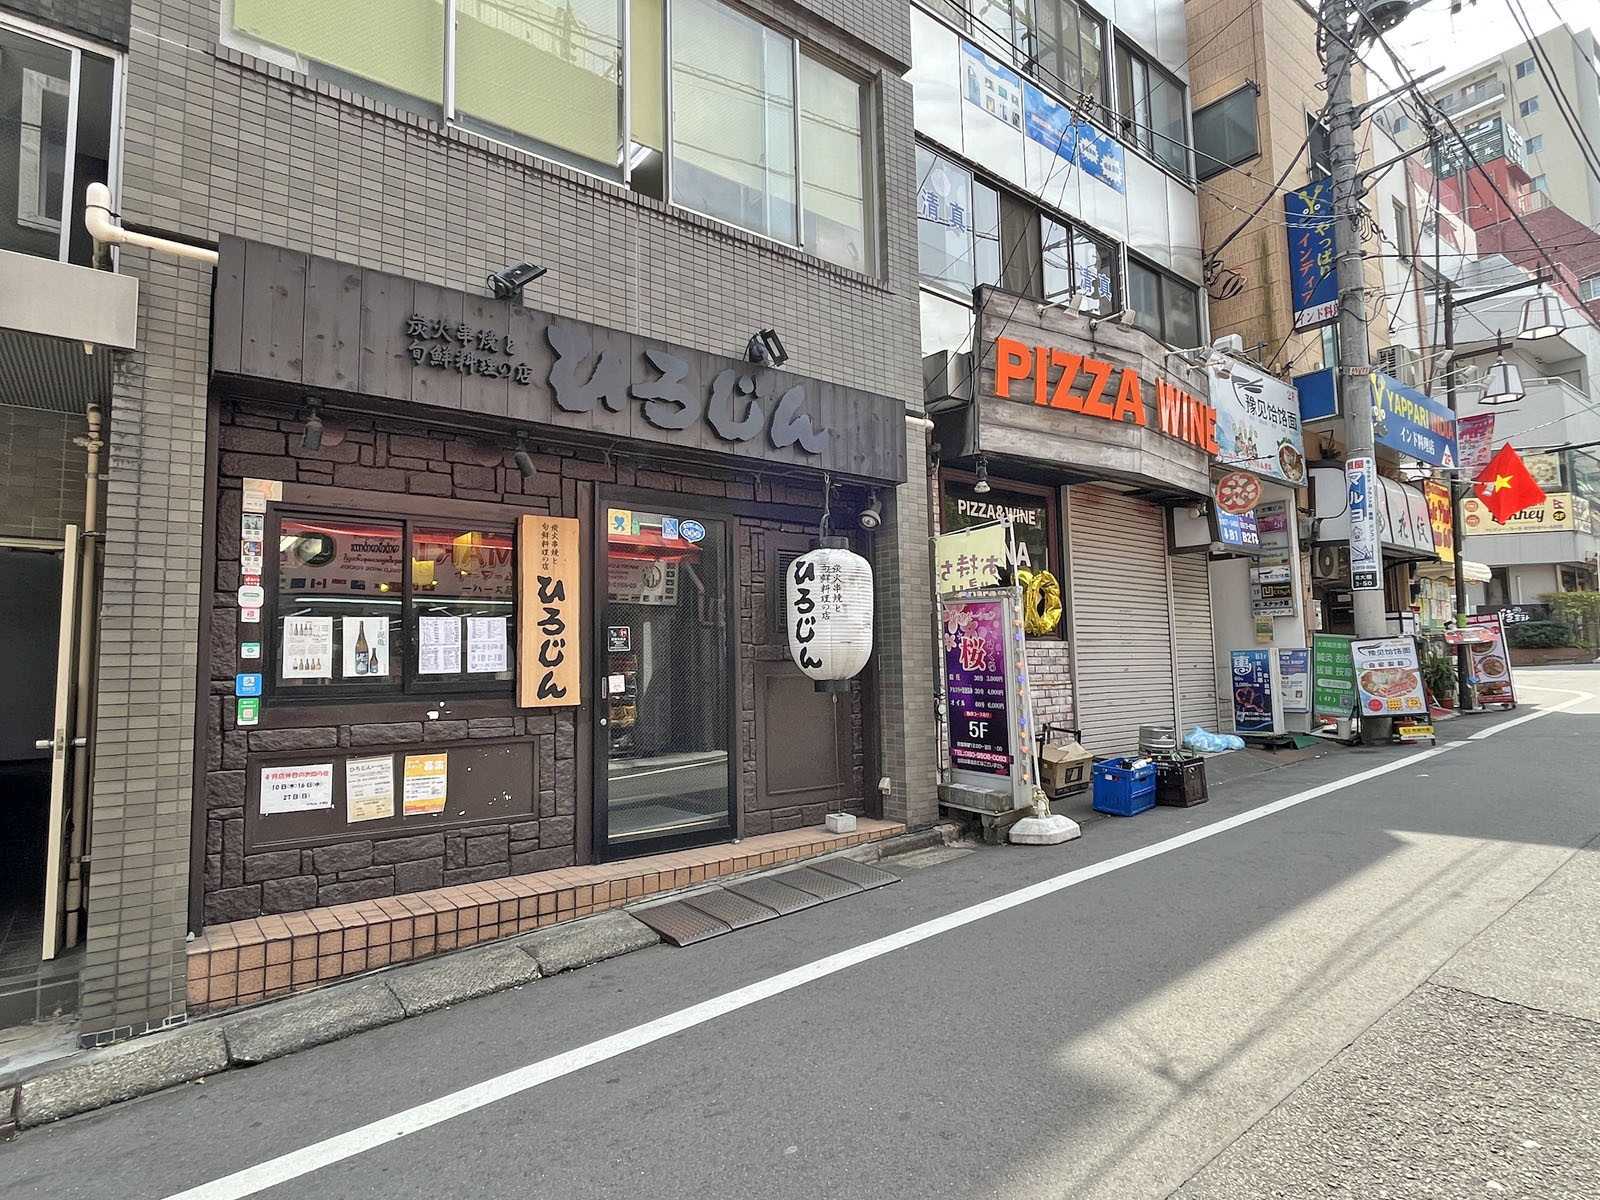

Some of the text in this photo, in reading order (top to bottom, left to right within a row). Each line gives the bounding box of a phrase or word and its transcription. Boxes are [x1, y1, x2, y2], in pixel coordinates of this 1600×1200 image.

[921, 188, 965, 233] 清真
[1078, 262, 1112, 302] 清真
[406, 312, 517, 357] 炭火串焼と
[407, 340, 534, 386] 旬鮮料理の店
[546, 324, 829, 454] ひろじん
[995, 336, 1219, 456] PIZZA WINE
[1386, 388, 1429, 430] YAPPARI
[1400, 426, 1435, 456] インド料理店
[537, 575, 567, 700] ひろじん
[793, 561, 822, 669] ひろじん
[960, 636, 986, 672] 桜
[969, 721, 989, 739] 5F
